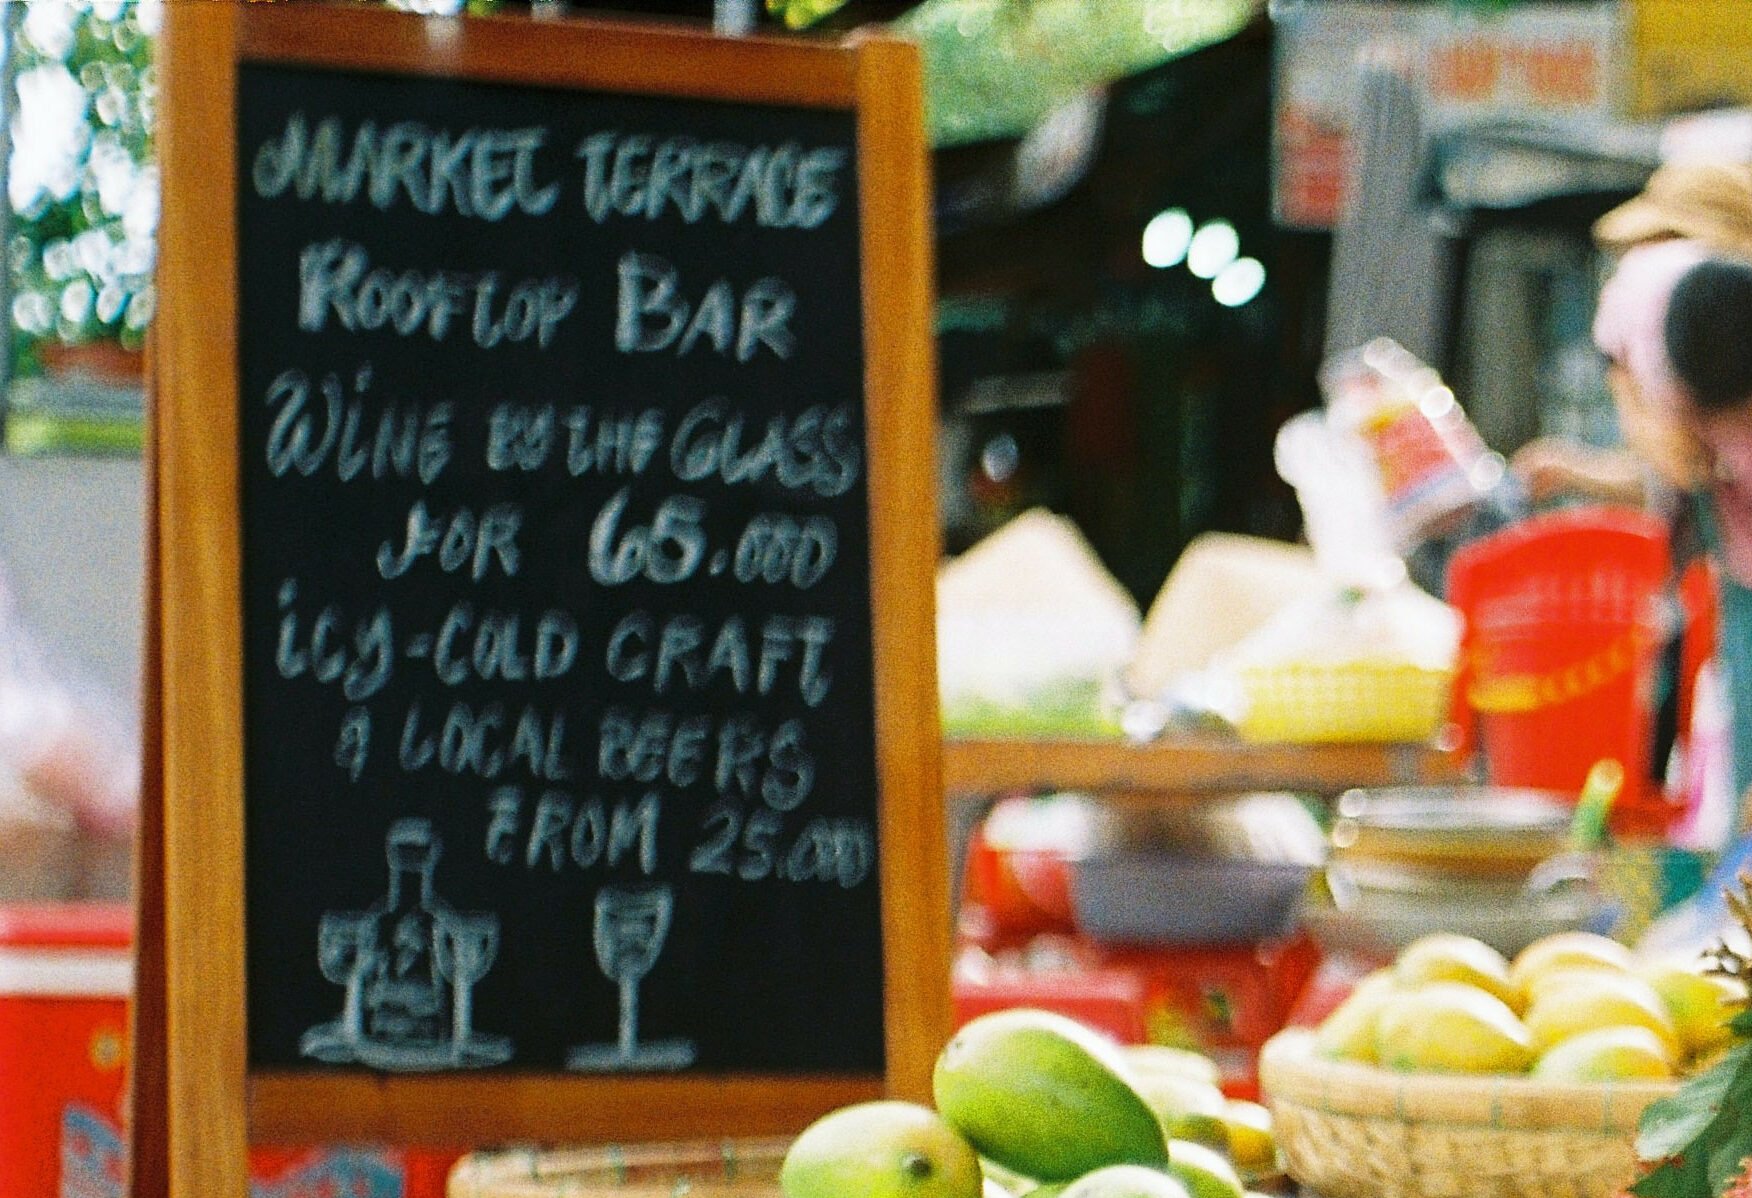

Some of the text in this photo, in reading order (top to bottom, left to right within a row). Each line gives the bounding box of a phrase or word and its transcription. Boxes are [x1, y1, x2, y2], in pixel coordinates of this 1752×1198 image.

[253, 112, 846, 229] MARKET TERRACE
[615, 249, 797, 361] BAR
[562, 403, 665, 478] THE
[668, 395, 861, 497] GLASS
[588, 484, 839, 590] 65.000
[605, 608, 836, 707] CRAFT
[400, 700, 572, 782] LOCAL
[600, 710, 816, 811] BEERS
[485, 785, 873, 890] FROM 25.000
